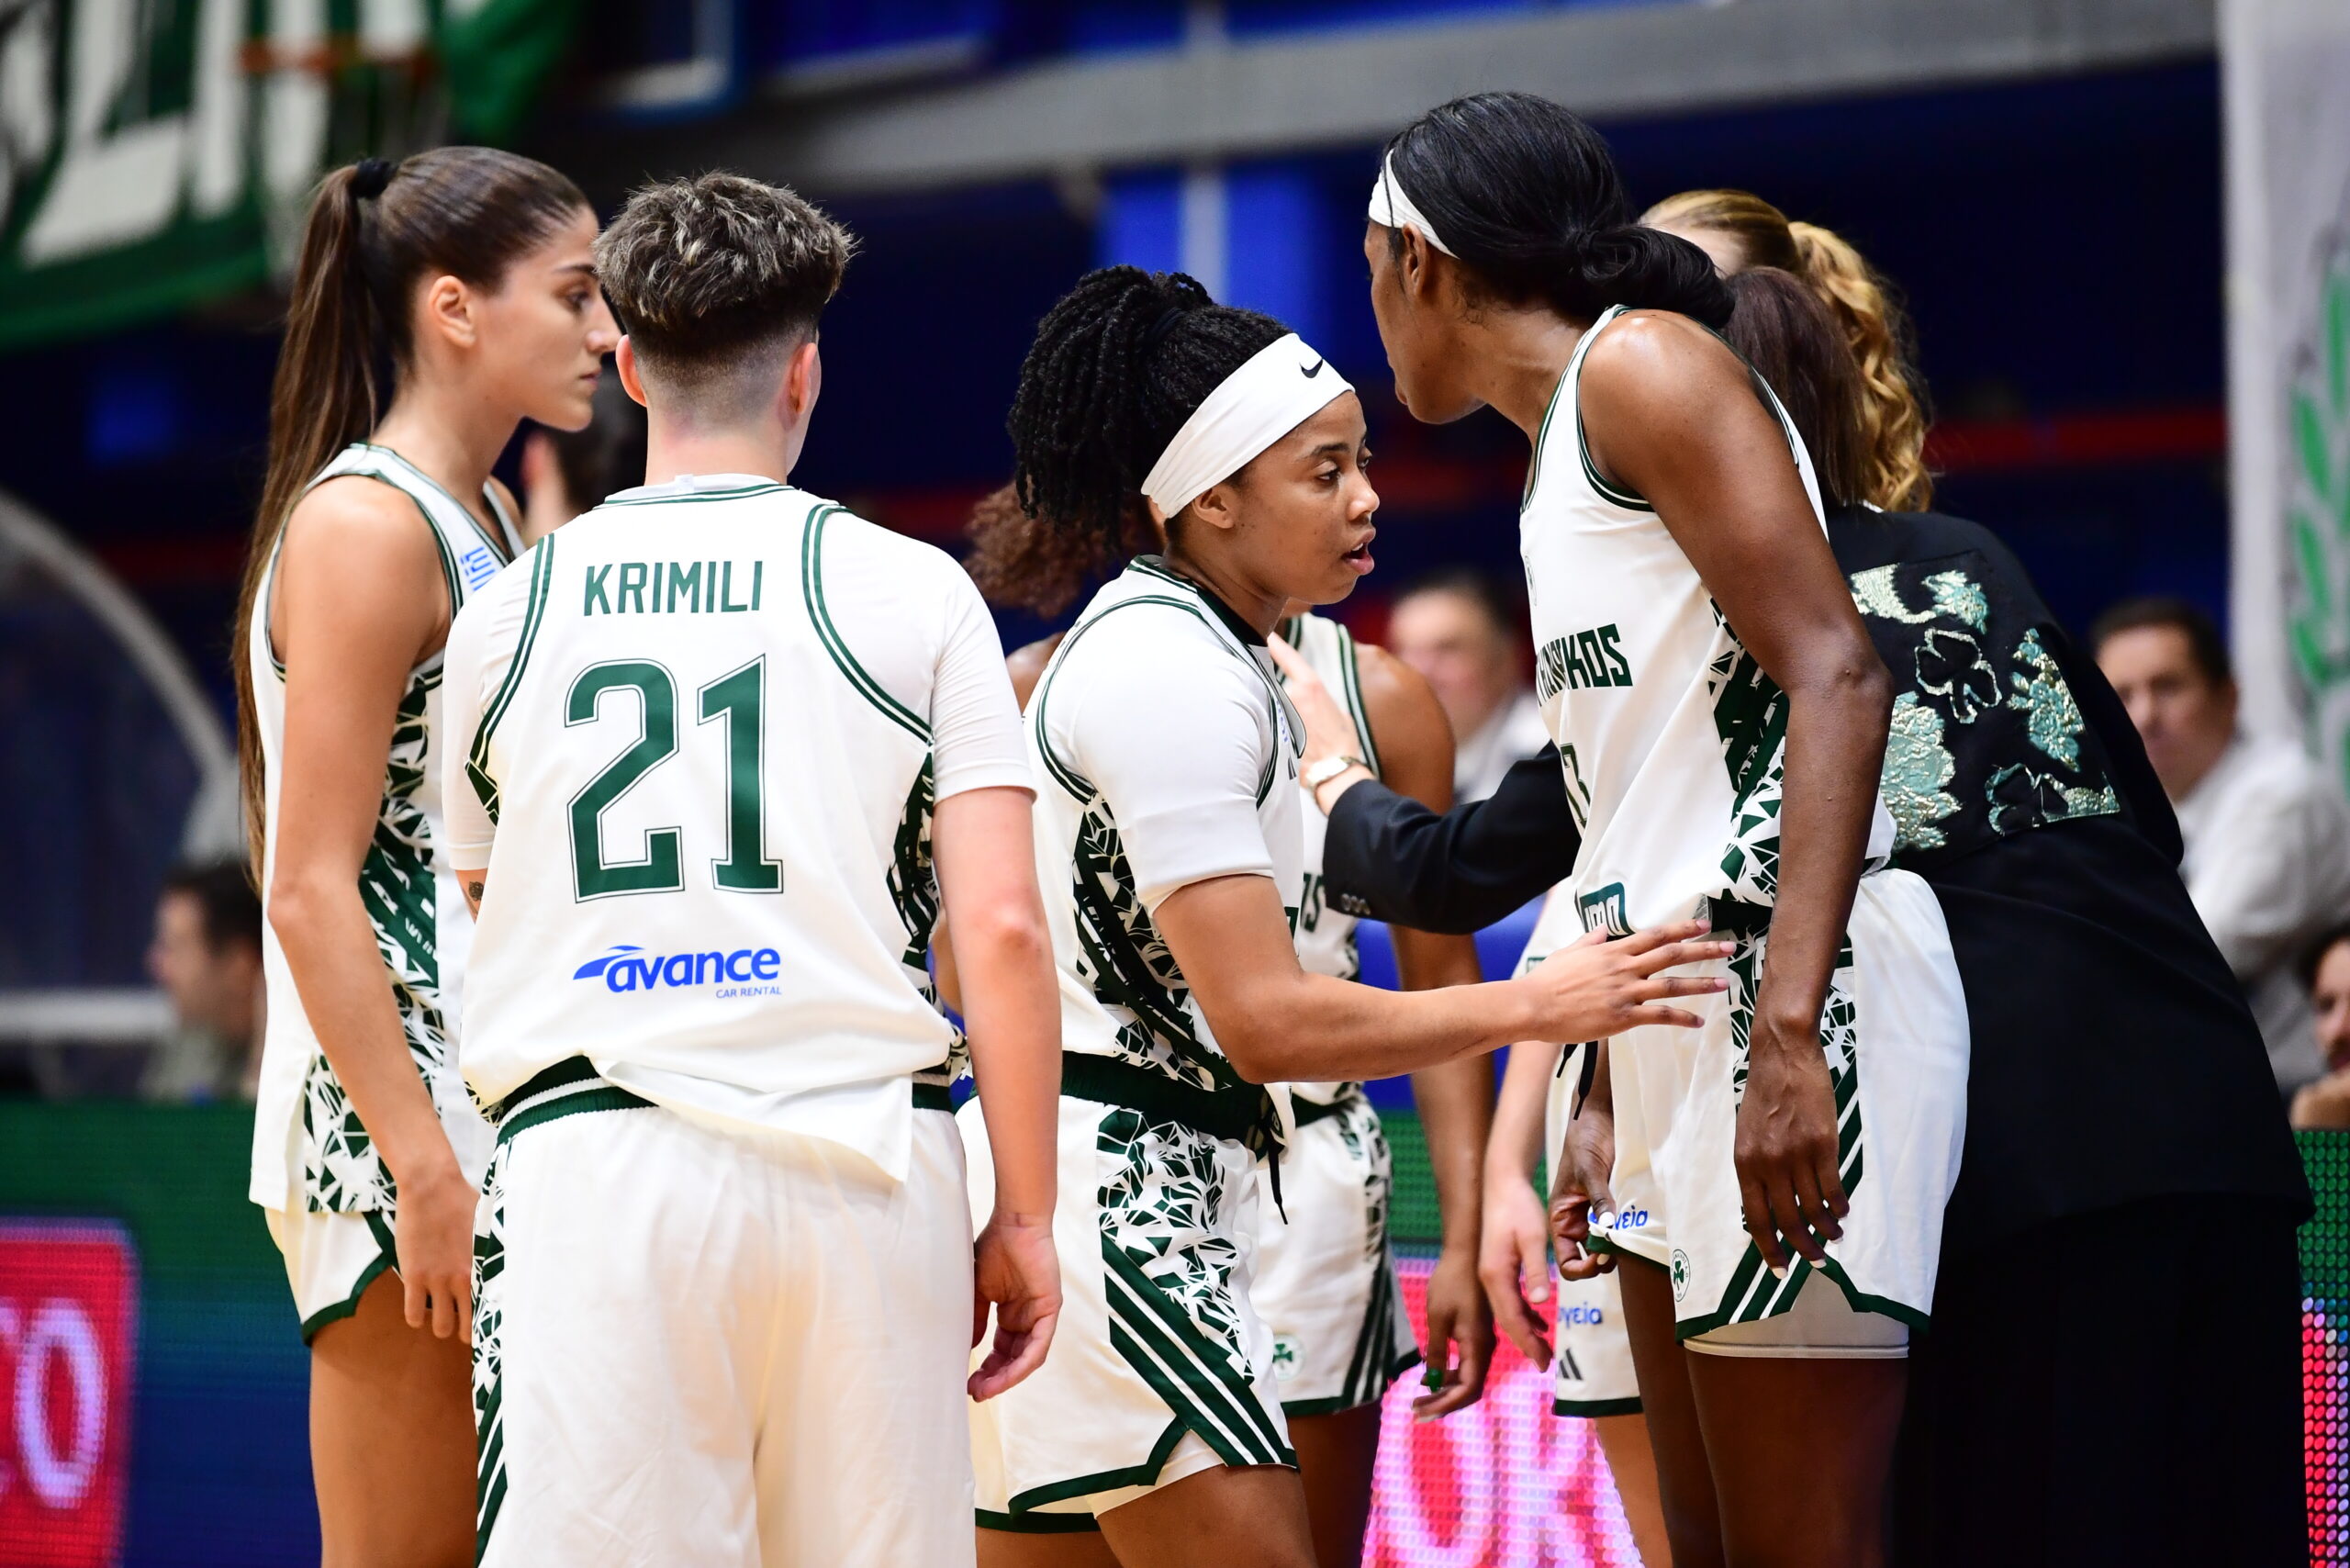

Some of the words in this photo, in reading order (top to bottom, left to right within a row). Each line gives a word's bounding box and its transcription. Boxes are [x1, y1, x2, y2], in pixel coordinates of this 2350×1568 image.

[583, 560, 763, 616] KRIMILI
[564, 653, 784, 903] 21
[601, 946, 781, 993] avance
[715, 988, 738, 999] CAR
[740, 986, 782, 998] RENTAL
